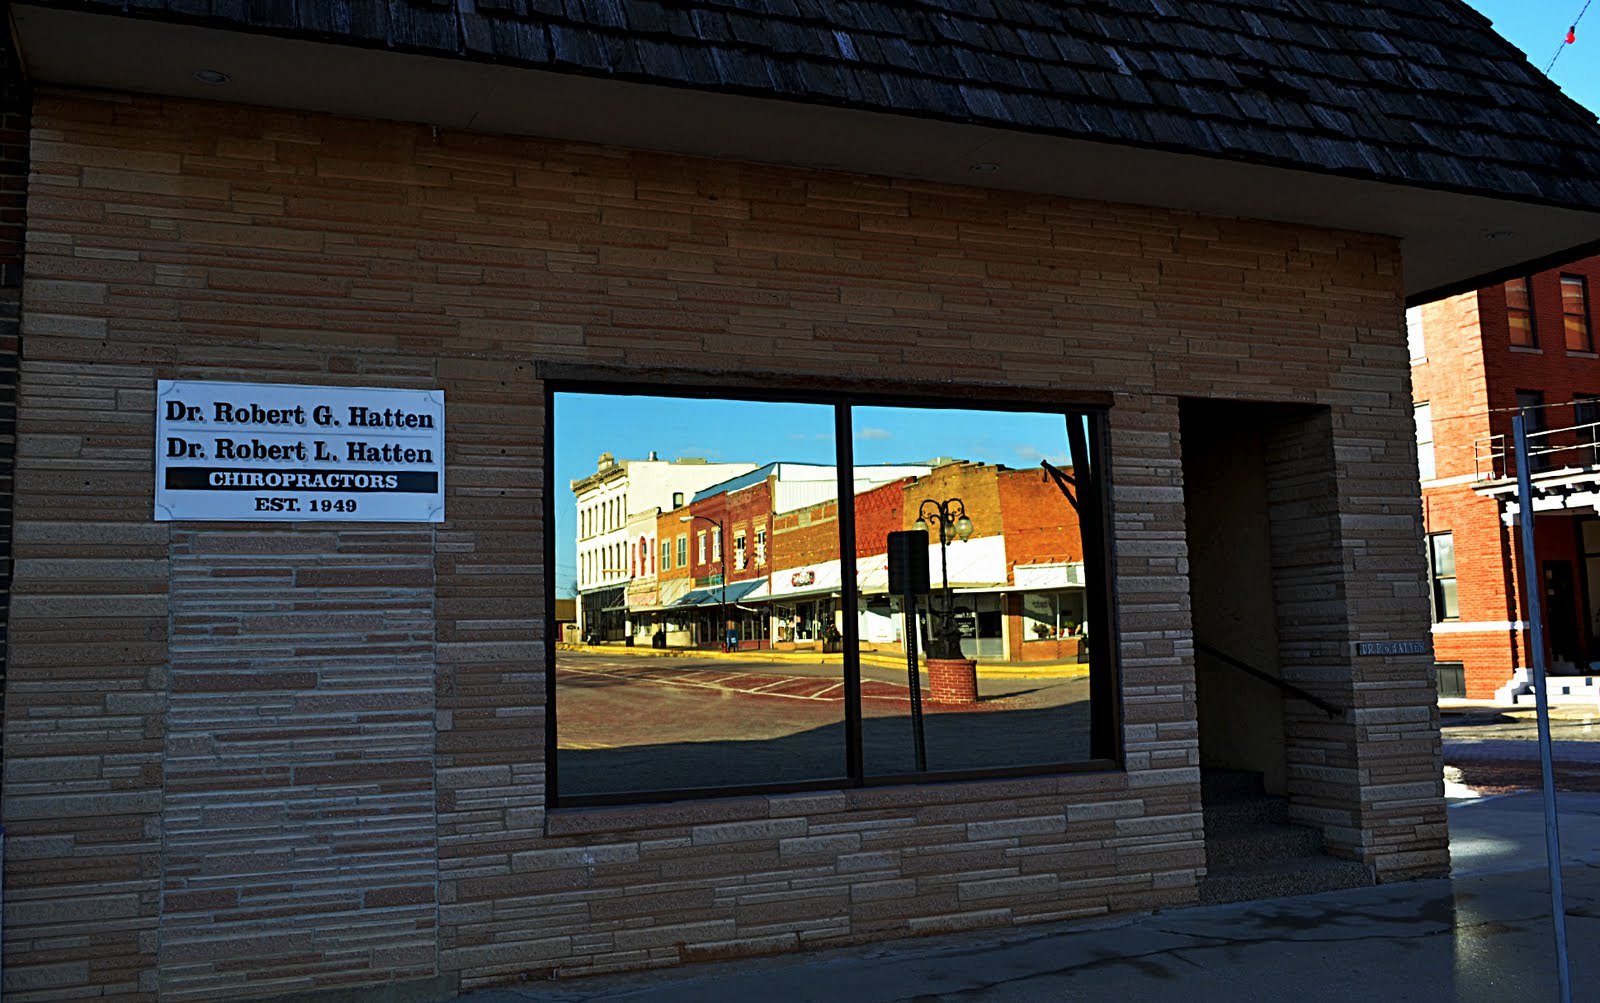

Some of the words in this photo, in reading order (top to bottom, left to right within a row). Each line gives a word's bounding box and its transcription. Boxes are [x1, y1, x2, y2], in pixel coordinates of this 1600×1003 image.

[165, 400, 204, 422] Dr.
[213, 402, 305, 425] Robert
[312, 405, 340, 426] G.
[348, 406, 434, 429] Hatten
[166, 437, 205, 459] Dr.
[214, 438, 306, 461] Robert
[313, 441, 338, 462] L.
[346, 441, 433, 463] Hatten
[208, 471, 398, 489] CHIROPRACTORS
[254, 497, 301, 512] EST.
[309, 499, 357, 513] 1949
